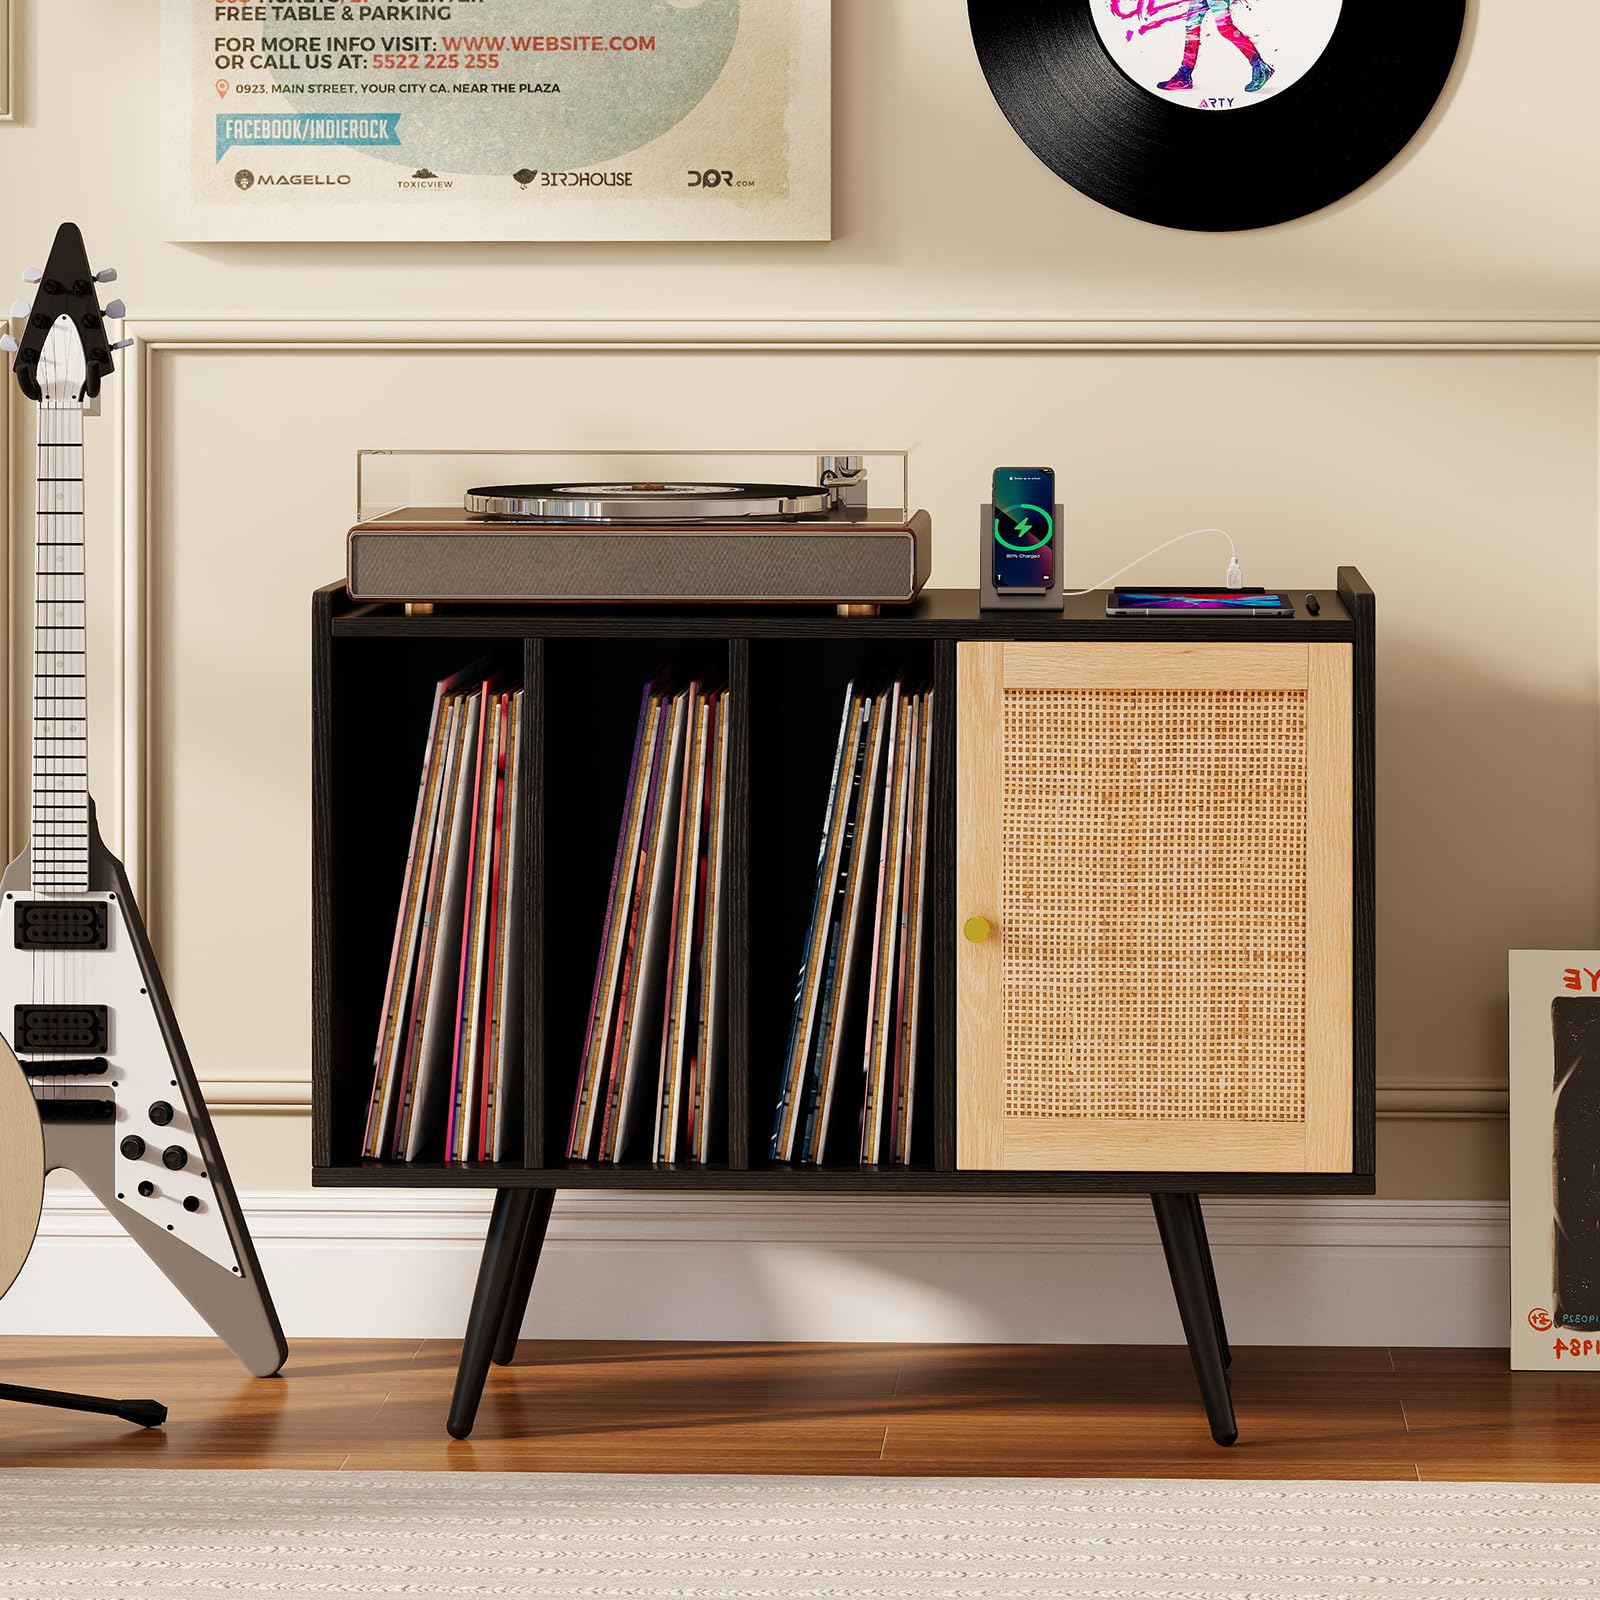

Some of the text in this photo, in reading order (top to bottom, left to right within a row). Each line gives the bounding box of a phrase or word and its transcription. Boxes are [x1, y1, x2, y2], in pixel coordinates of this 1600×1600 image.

[215, 6, 451, 21] FREE TABLE & PARKING
[214, 36, 656, 52] FOR MORE INFO VISIT: WWW.WEBSITE.COM
[215, 54, 500, 69] OR CALL US AT: 5522 225 255
[235, 84, 561, 95] 0923, MAIN STREET, YOUR CITY CA. NEAR THE PLAZA
[1198, 98, 1235, 108] ARTY
[225, 119, 389, 140] FACEBOOK/INDIEROCK
[257, 174, 351, 186] MAGELLO
[541, 172, 633, 187] BIRDHOUSE
